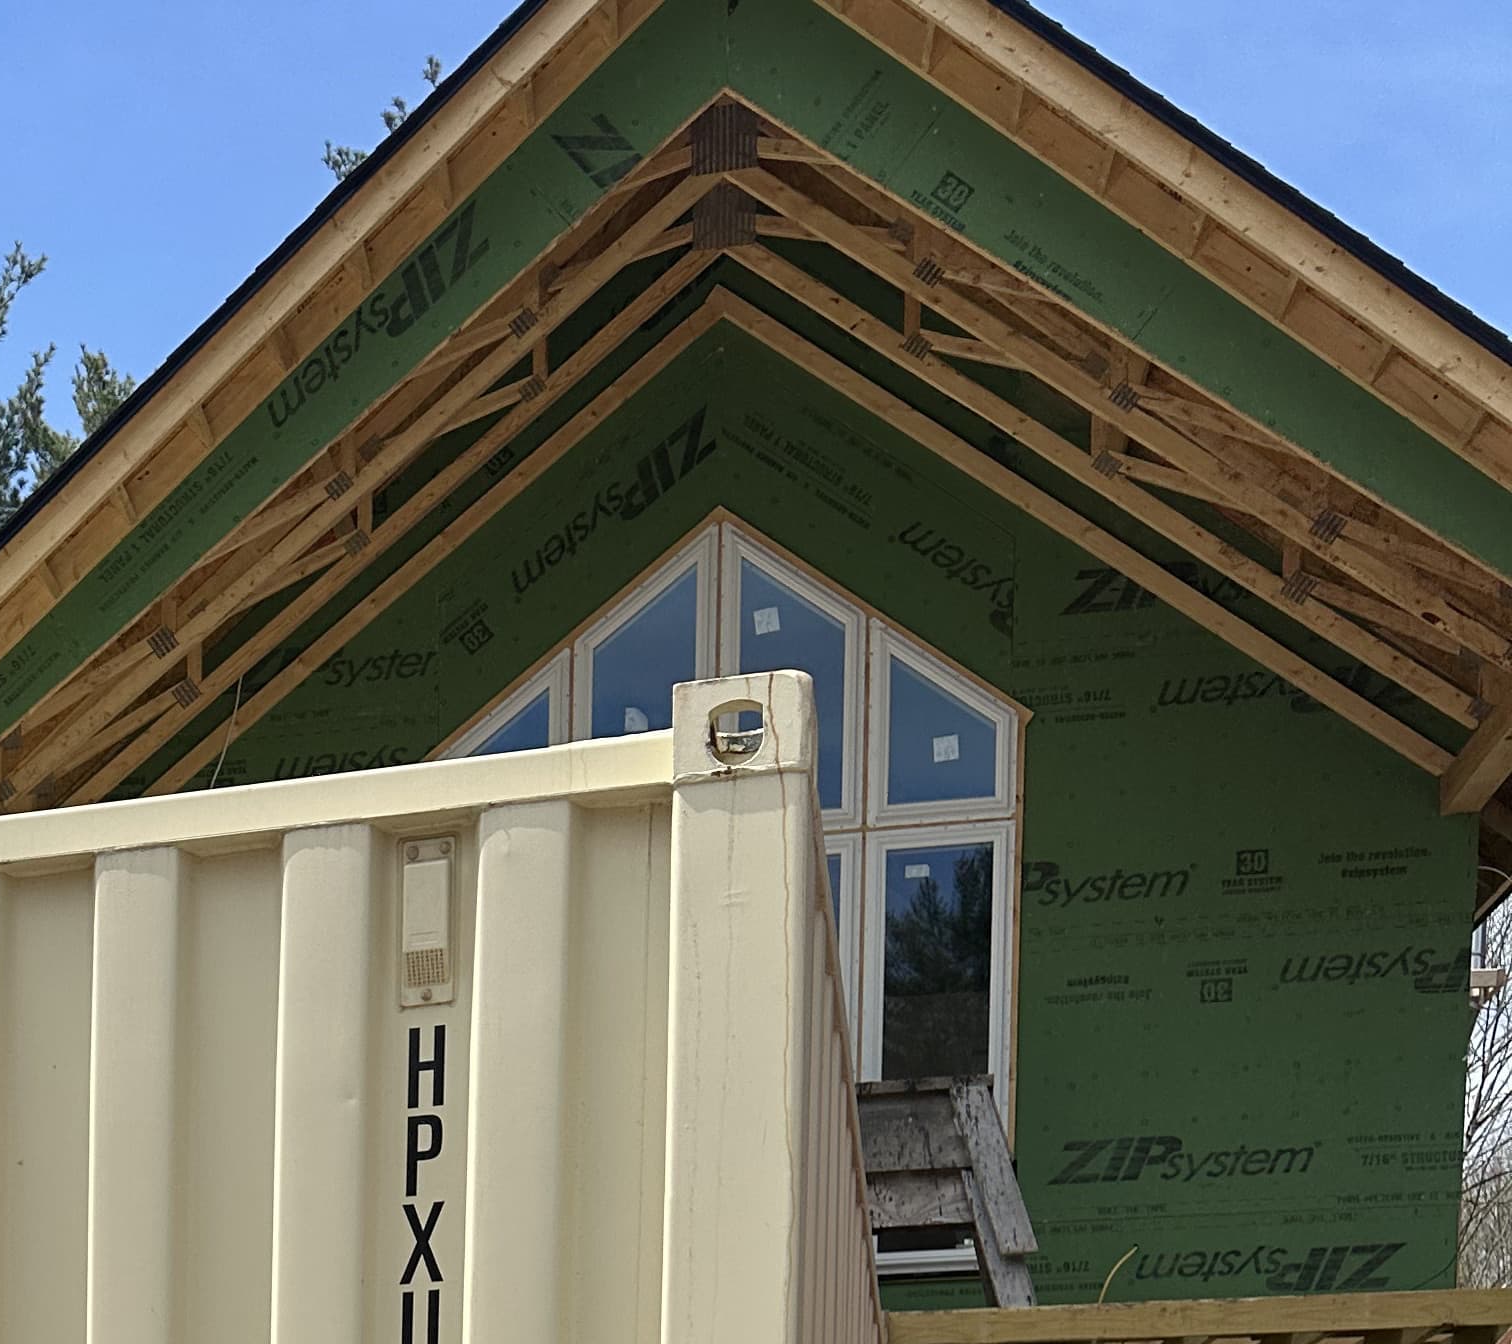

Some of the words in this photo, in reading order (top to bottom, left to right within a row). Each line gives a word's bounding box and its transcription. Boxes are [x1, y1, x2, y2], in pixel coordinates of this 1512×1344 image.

[936, 173, 972, 208] 30
[1023, 860, 1190, 908] Psystem
[1238, 851, 1267, 873] 30
[1279, 945, 1471, 993] Psystem
[1046, 1136, 1316, 1186] ZIPsystem
[1135, 1242, 1407, 1291] ZIPsystem
